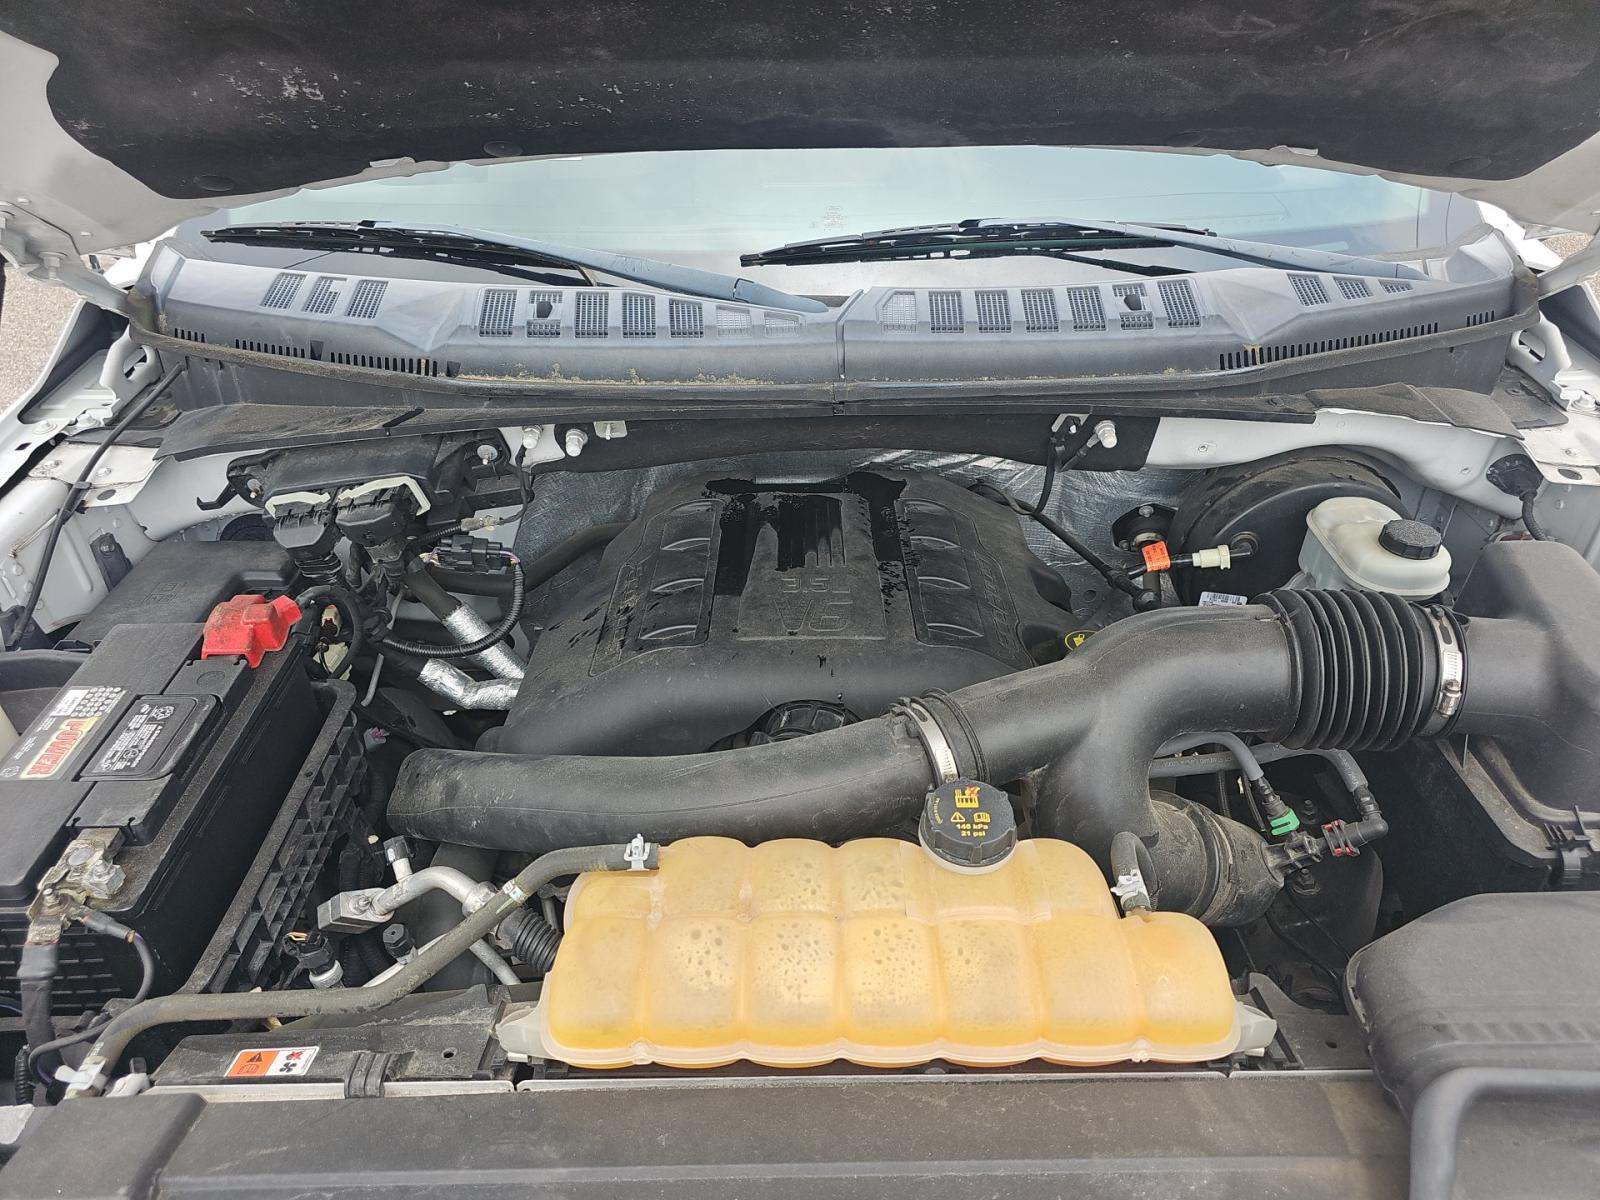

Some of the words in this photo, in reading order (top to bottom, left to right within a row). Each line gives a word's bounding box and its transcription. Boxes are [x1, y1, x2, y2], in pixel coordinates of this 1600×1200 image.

[781, 577, 851, 593] 3.5L
[774, 599, 854, 632] V6
[25, 719, 88, 776] POWER
